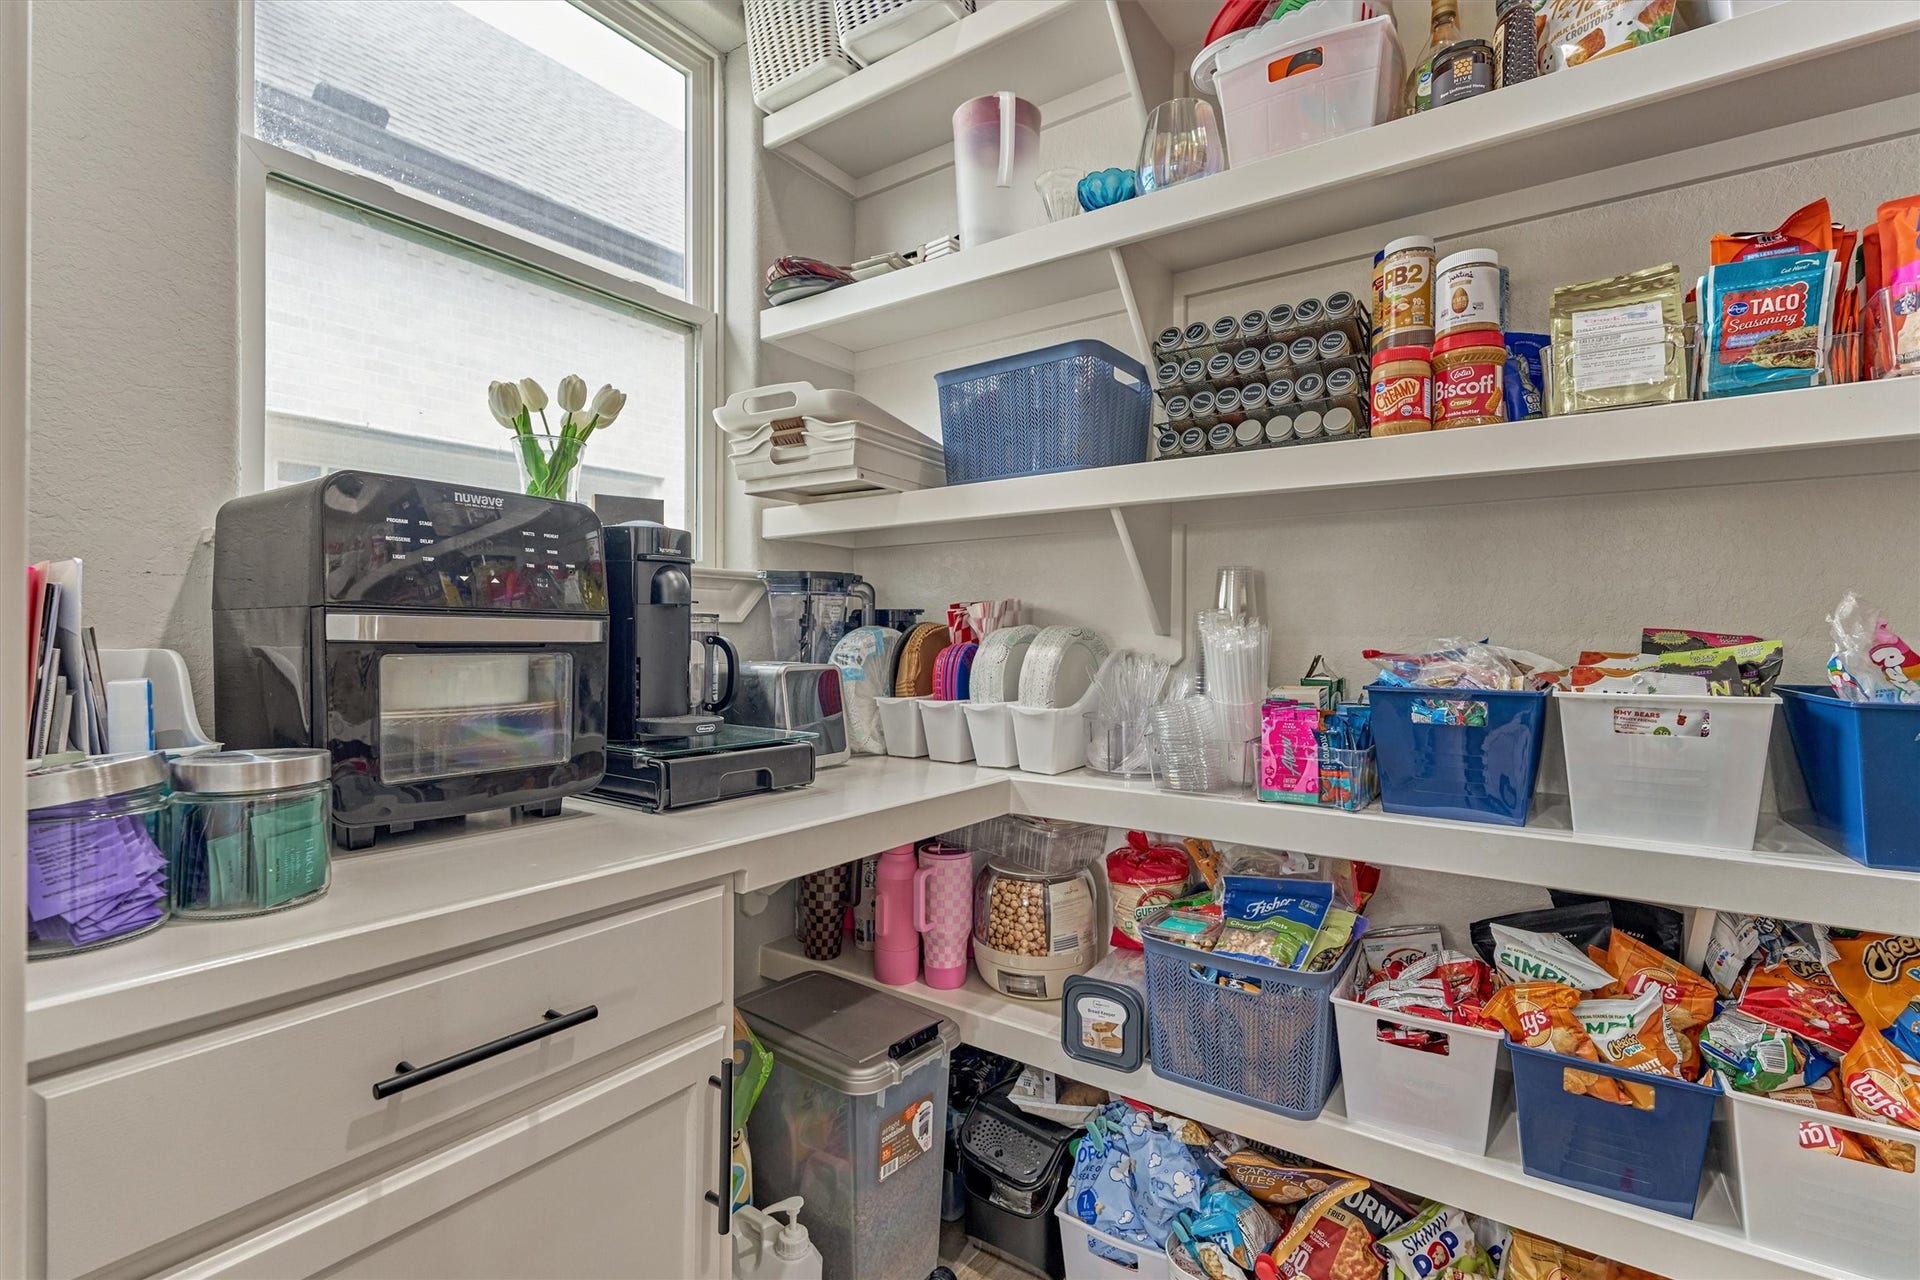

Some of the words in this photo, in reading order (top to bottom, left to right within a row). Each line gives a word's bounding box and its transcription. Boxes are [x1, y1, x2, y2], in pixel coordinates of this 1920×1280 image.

[1565, 10, 1614, 42] CROUTONS
[1577, 9, 1602, 26] BUTTER
[1454, 75, 1472, 83] HIVE
[1385, 264, 1423, 290] PB2
[1750, 293, 1800, 315] TACO
[1728, 313, 1798, 333] Seasoning
[1375, 379, 1419, 411] CREAMY
[1435, 375, 1494, 401] Biscoff
[1450, 399, 1473, 407] Creamy
[455, 491, 503, 507] nuwave
[1634, 710, 1660, 718] BEARS
[1243, 896, 1296, 919] Fisher
[1230, 919, 1262, 930] Chopped
[1866, 935, 1920, 979] Chee
[1607, 1033, 1640, 1060] Cheetos
[1850, 1074, 1904, 1118] Lay's
[1327, 1208, 1346, 1222] FRIED
[1401, 1212, 1448, 1256] SKINNY
[1412, 1231, 1459, 1279] POP
